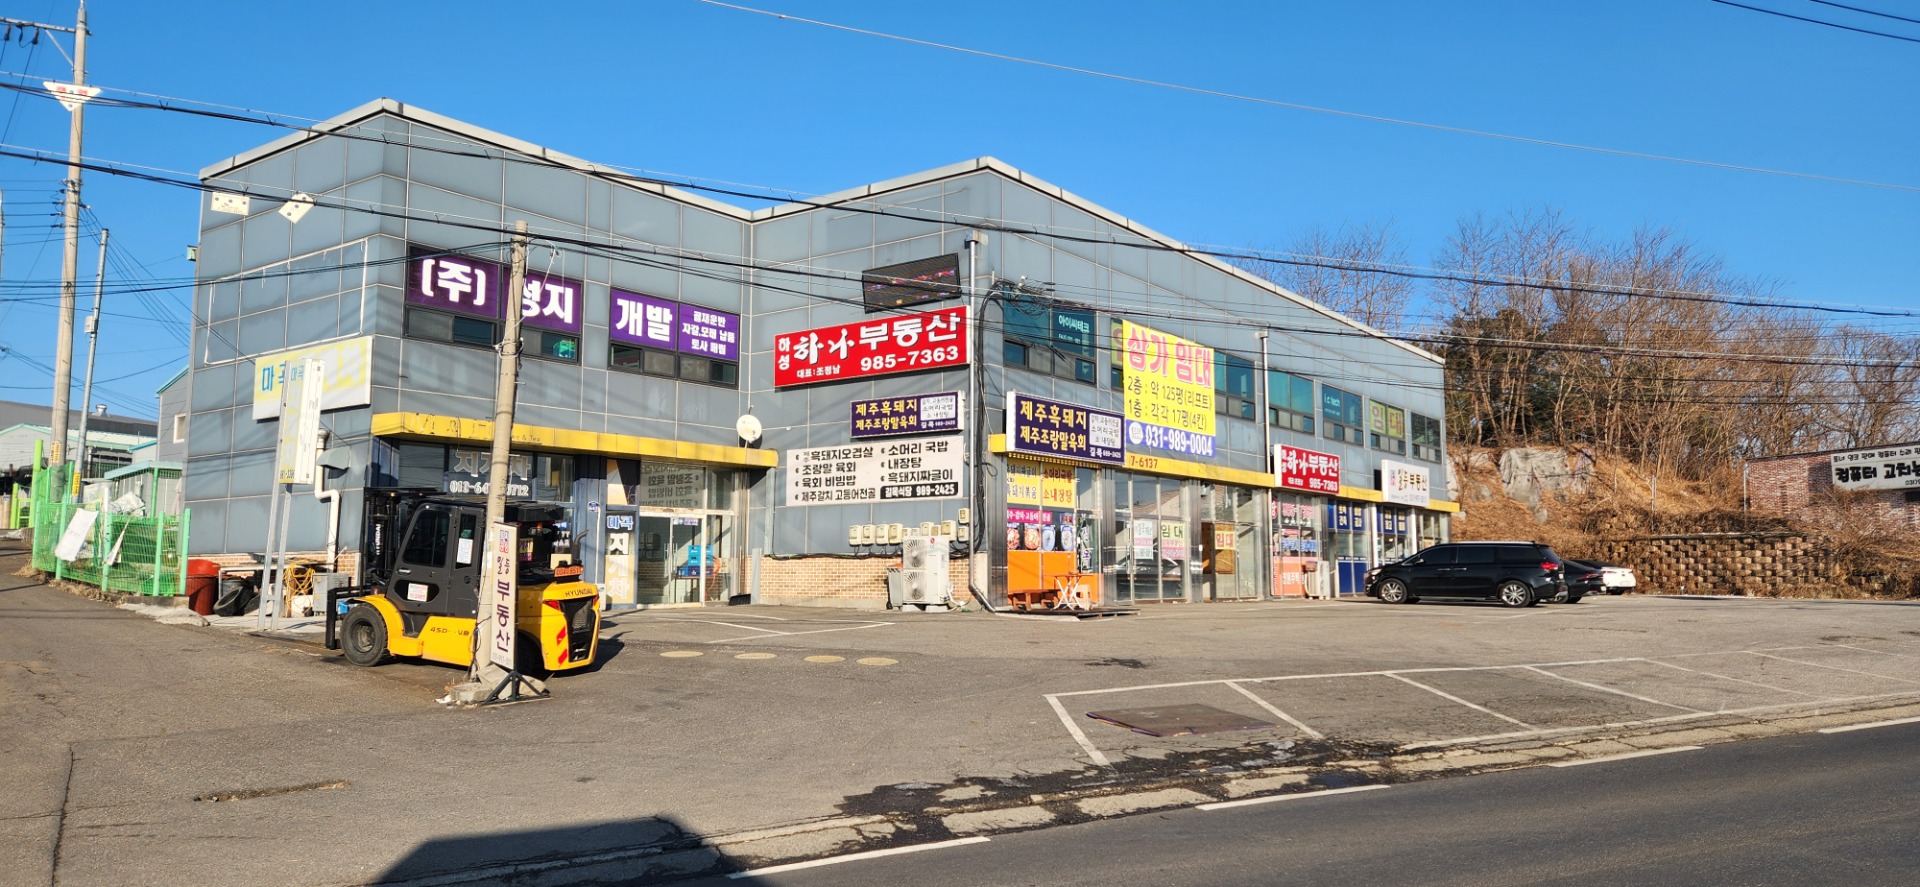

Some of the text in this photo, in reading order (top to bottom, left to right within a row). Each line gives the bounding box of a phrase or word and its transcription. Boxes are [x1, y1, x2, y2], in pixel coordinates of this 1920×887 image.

[421, 258, 486, 306] (주)
[616, 298, 673, 342] 개발
[1058, 315, 1090, 333] 아이씨테크
[778, 337, 790, 370] 하성
[860, 345, 959, 371] 985-7363
[1127, 326, 1168, 377] 상가
[1175, 341, 1212, 388] 임대
[1128, 376, 1142, 396] 2층
[1151, 381, 1159, 397] 약
[855, 398, 917, 417] 제주흑돼지
[1020, 400, 1087, 429] 제주흑돼지
[1128, 399, 1142, 418] 1층
[1151, 403, 1169, 420] 각각
[855, 415, 917, 431] 제주조랑말육회
[1371, 402, 1403, 438] 임대
[1020, 425, 1087, 452] 제주조랑말육회
[1145, 425, 1213, 457] 031-989-0004
[811, 446, 874, 461] 흑돼지오겹살
[888, 440, 949, 456] 소머리 국밥
[802, 461, 856, 475] 조랑말 육회
[888, 457, 922, 469] 내장탕
[1130, 455, 1158, 469] 7-6137
[802, 475, 856, 488] 육회 비빔밥
[888, 469, 953, 483] 흑돼지짜글이
[1835, 466, 1878, 483] 컴퓨터
[835, 488, 876, 500] 고등어전골
[916, 484, 955, 496] 989-2425
[608, 533, 630, 600] 지게차
[565, 588, 593, 597] HYUNDAI
[496, 579, 510, 653] 부동산
